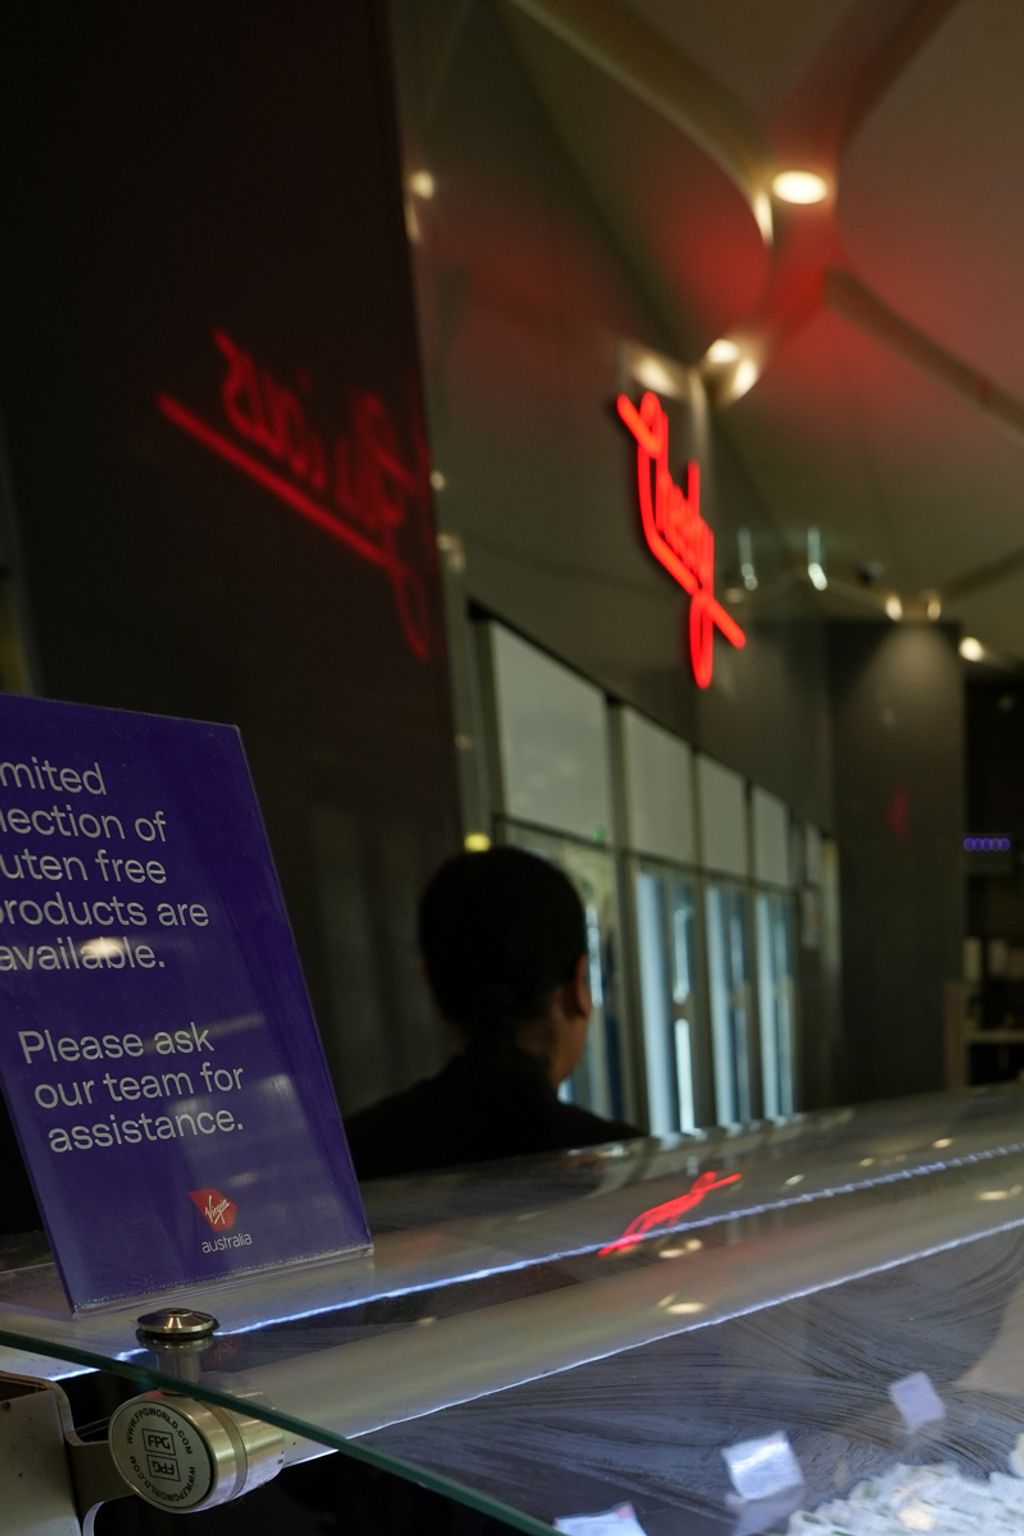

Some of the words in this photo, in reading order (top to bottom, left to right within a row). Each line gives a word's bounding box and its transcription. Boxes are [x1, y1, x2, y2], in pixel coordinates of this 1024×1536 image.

[0, 756, 107, 796] mited
[134, 810, 167, 842] of
[0, 848, 88, 881] uten
[95, 848, 167, 884] free
[156, 902, 209, 927] are
[0, 935, 165, 971] available.
[17, 1029, 144, 1064] Please
[153, 1021, 215, 1054] ask
[33, 1079, 95, 1109] our
[102, 1072, 194, 1102] team
[199, 1061, 244, 1092] for
[48, 1108, 244, 1153] assistance.
[201, 1232, 253, 1254] australia
[147, 1434, 171, 1450] FPG
[151, 1460, 175, 1476] FPG
